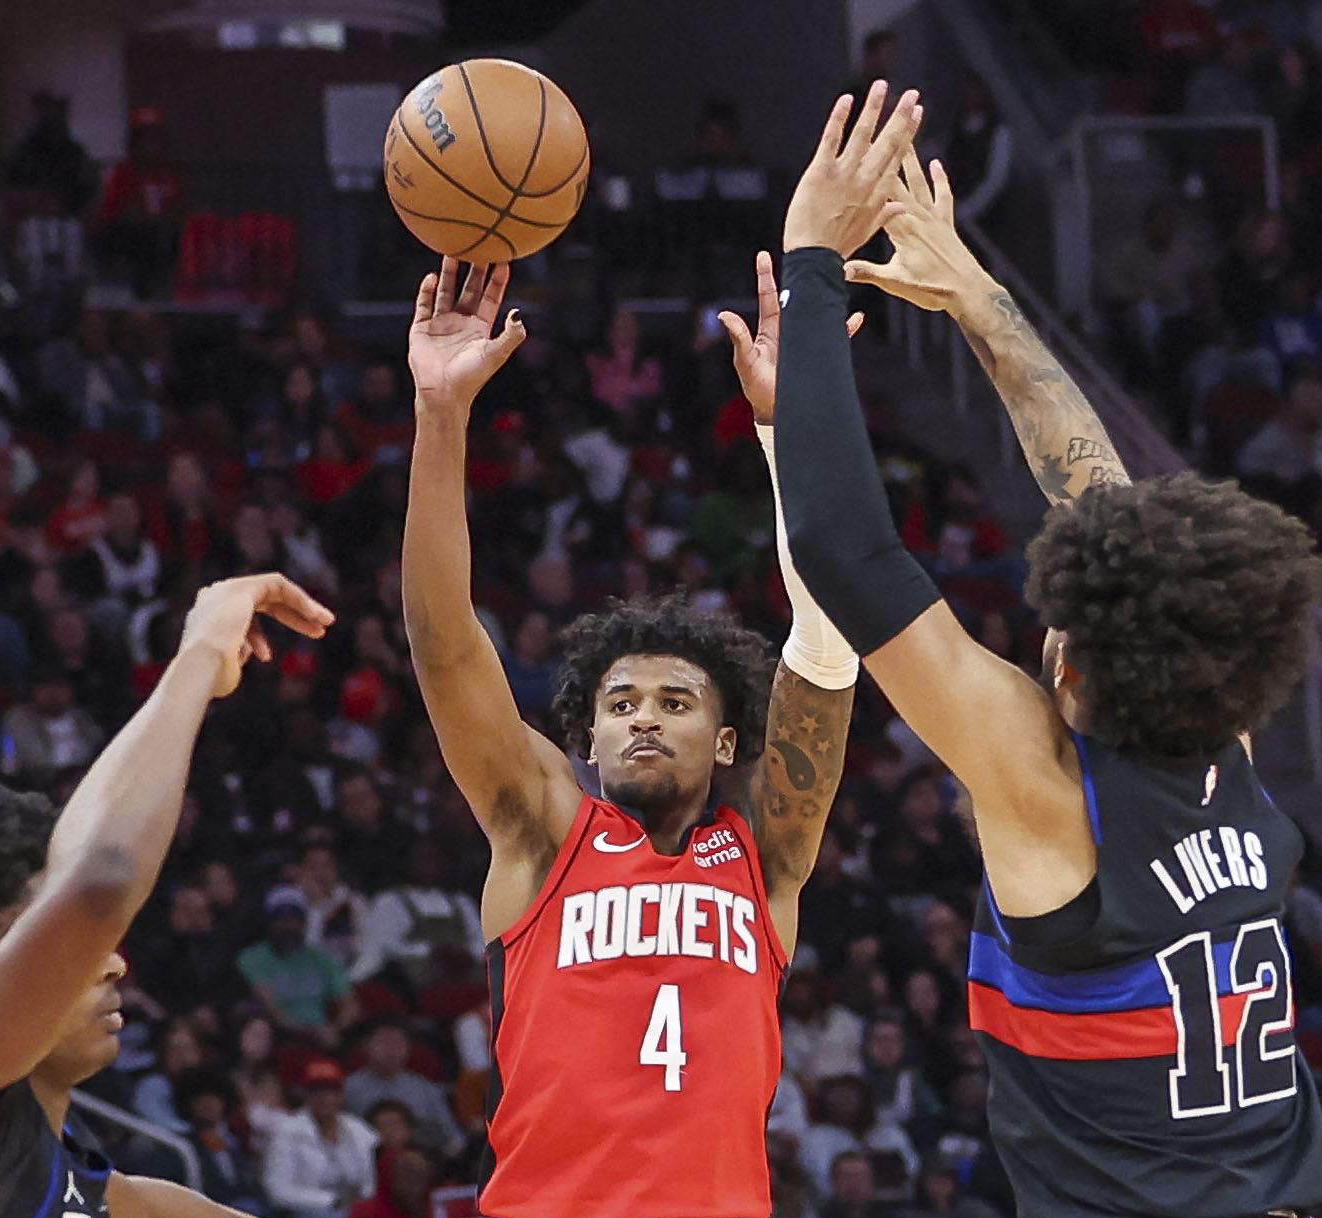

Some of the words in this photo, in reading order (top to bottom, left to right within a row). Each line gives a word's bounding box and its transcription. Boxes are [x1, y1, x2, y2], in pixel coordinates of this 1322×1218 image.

[693, 846, 743, 868] arma
[1150, 826, 1269, 914] LIVERS
[556, 882, 758, 975] ROCKETS
[638, 982, 688, 1092] 4
[1154, 917, 1298, 1120] 12
